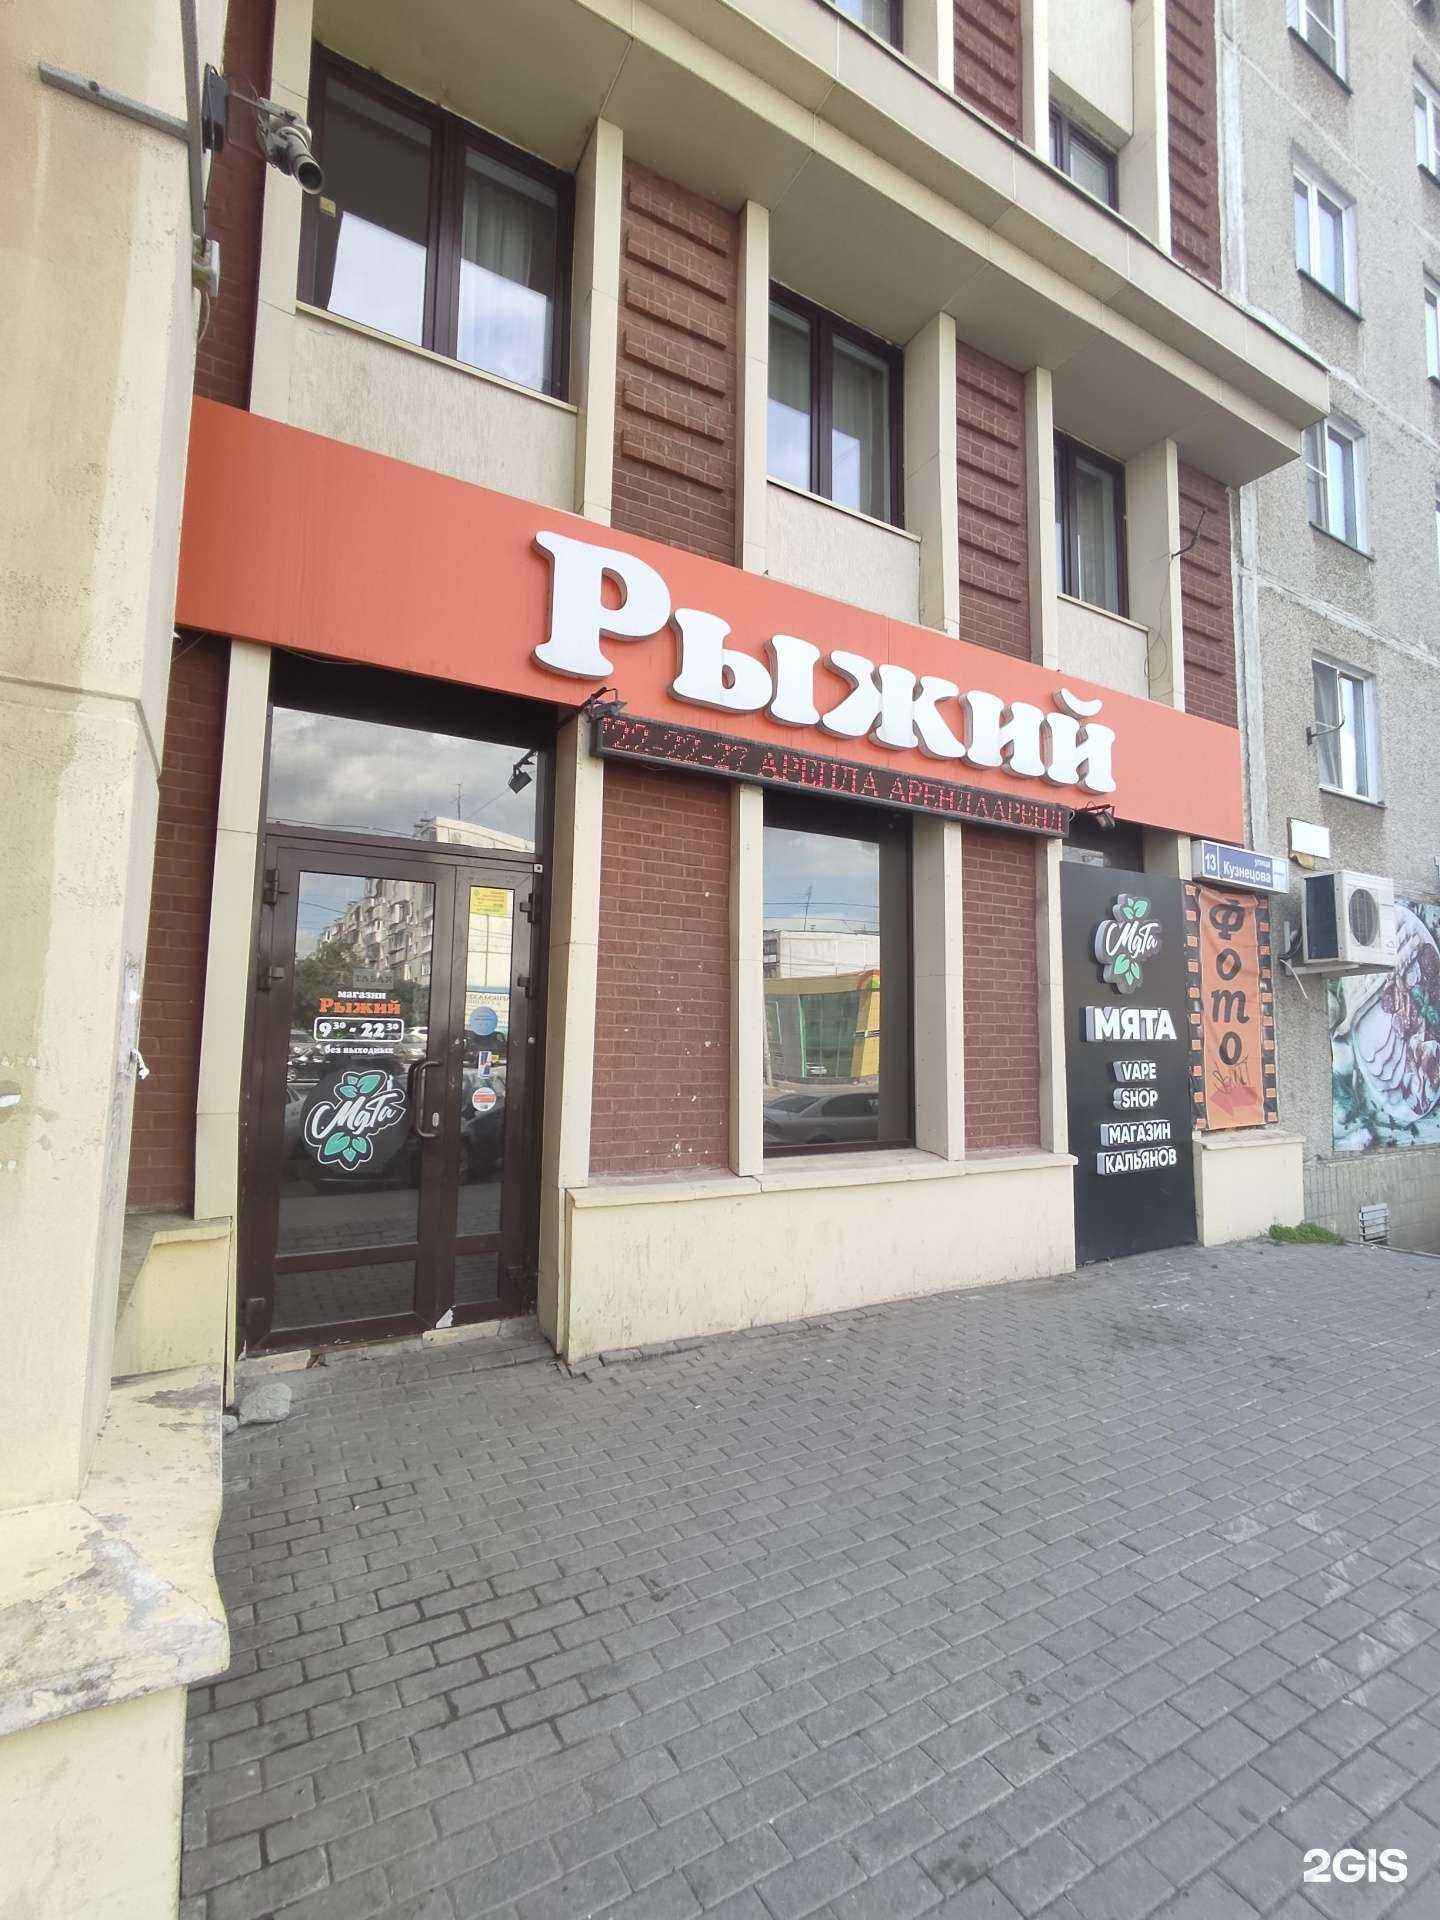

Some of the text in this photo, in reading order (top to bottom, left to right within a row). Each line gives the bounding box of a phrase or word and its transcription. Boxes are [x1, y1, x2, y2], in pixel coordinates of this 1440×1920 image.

[530, 530, 1117, 794] Рыжий
[1205, 853, 1217, 871] 13
[1223, 861, 1272, 882] Кузнецова
[337, 991, 387, 1000] магазин
[319, 998, 401, 1014] Рыжий
[1092, 1007, 1178, 1041] МЯТА
[324, 1043, 394, 1055] без выходных
[1120, 1061, 1157, 1080] VAPE
[1120, 1089, 1159, 1109] SHOP
[1108, 1121, 1171, 1144] МАГАЗИН
[1104, 1148, 1177, 1174] КАЛЬЯНОВ
